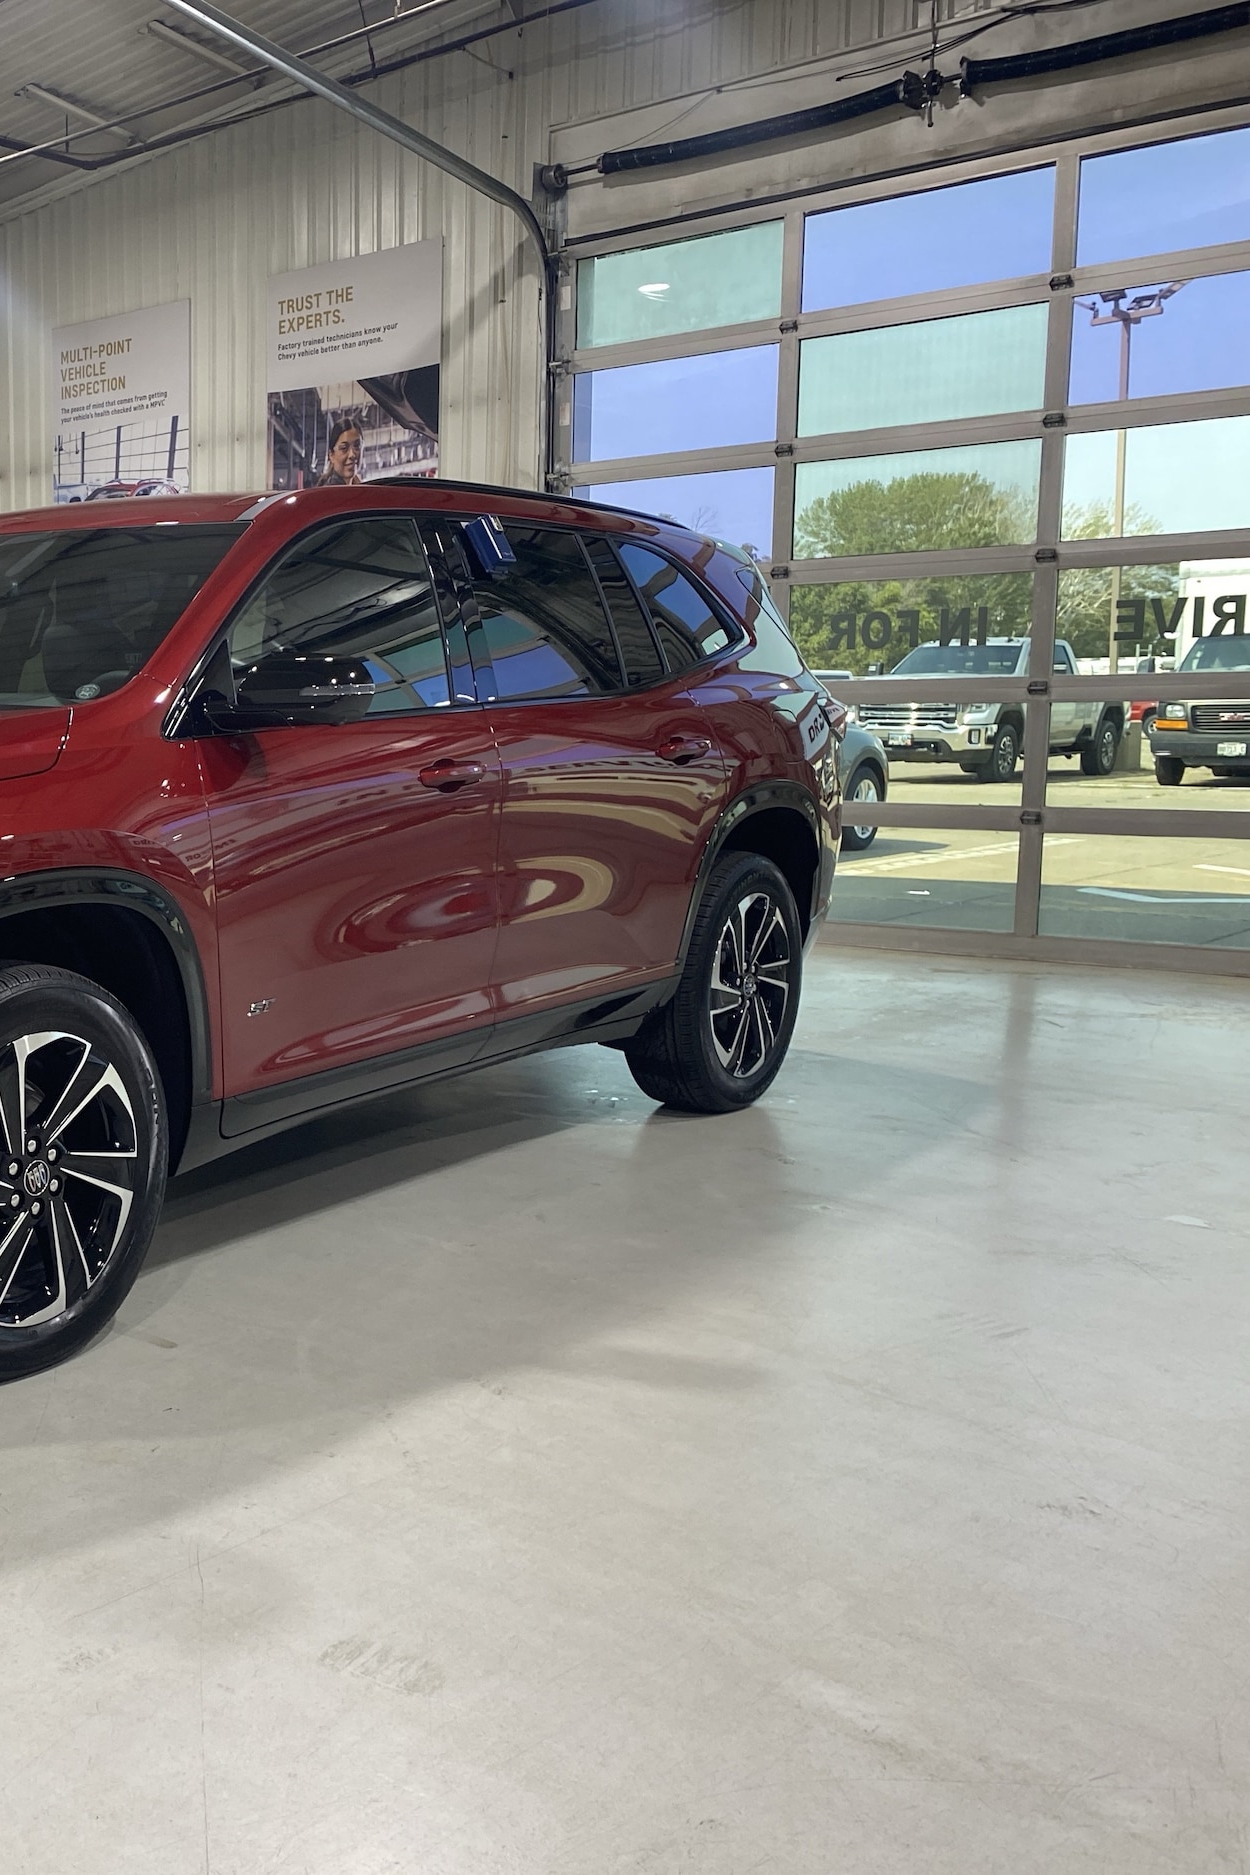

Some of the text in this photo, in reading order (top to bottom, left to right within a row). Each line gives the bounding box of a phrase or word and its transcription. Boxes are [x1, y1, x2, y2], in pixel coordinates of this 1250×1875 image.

[278, 286, 354, 316] TRUST THE
[278, 309, 345, 335] EXPERTS.
[277, 336, 383, 361] Chevy vehicle better than anyone.
[278, 322, 398, 351] Factory trained technicians know your
[60, 338, 132, 365] MULTI-POINT
[60, 361, 106, 382] VEHICLE
[60, 375, 126, 400] INSPECTION
[60, 407, 70, 415] The
[70, 405, 85, 414] peace
[92, 402, 104, 410] mind
[105, 400, 116, 408] that
[117, 397, 133, 405] comes
[134, 395, 147, 403] from
[148, 391, 168, 401] getting
[60, 416, 72, 425] your
[94, 409, 110, 418] health
[111, 406, 132, 416] checked
[133, 403, 145, 412] with
